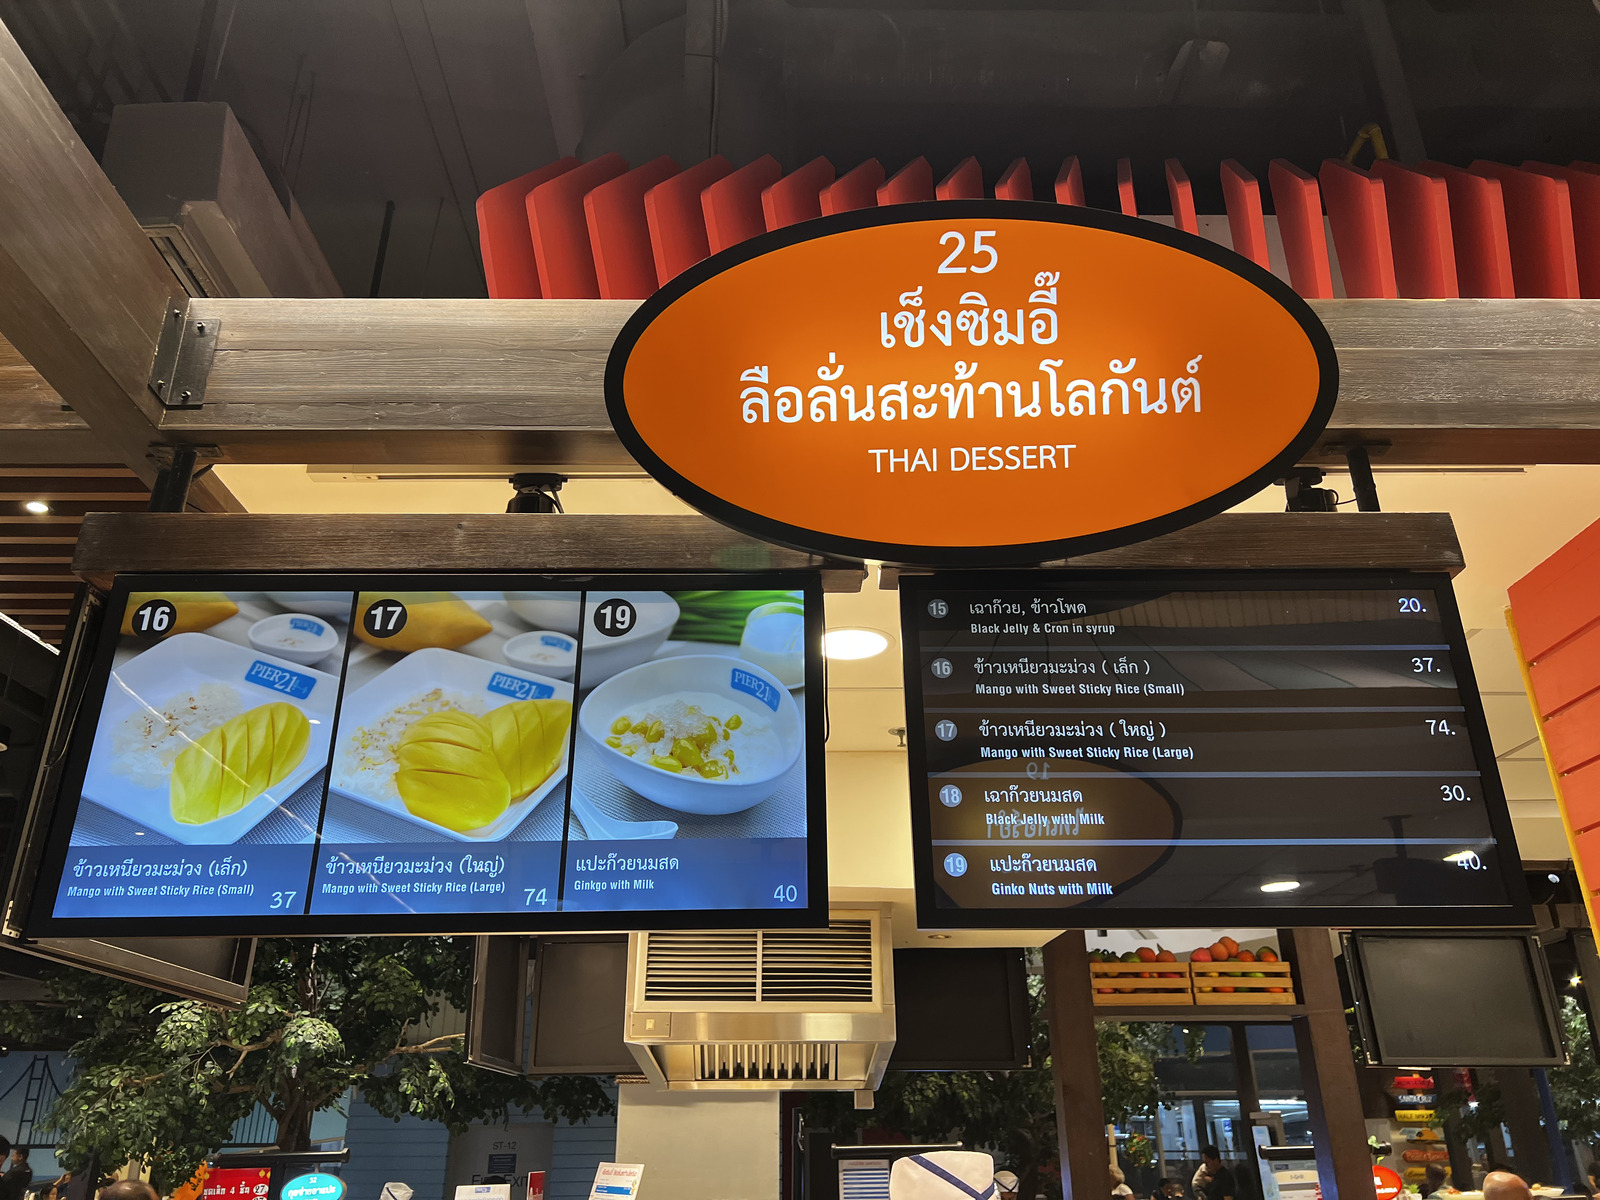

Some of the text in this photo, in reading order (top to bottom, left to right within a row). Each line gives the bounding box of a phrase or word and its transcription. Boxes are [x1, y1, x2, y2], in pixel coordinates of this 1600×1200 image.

[937, 230, 998, 274] 25
[739, 351, 1203, 424] ลือลั่นสะท้านโลกันต์
[867, 444, 1077, 473] THAI DESSERT
[929, 602, 947, 616] 15
[969, 597, 1087, 616] เฉาก๊วย, ข้าวโพด
[1398, 597, 1427, 613] 20.
[138, 606, 170, 631] 16
[371, 605, 403, 631] 17
[600, 605, 631, 630] 19
[970, 622, 1115, 636] Black Jelly & Cron in syrup
[933, 661, 951, 676] 16
[973, 657, 1096, 674] ข้าวเหนียวมะม่วง
[1411, 657, 1441, 673] 37.
[975, 683, 1185, 697] Mango with Sweet Sticky Rice (Small)
[937, 724, 955, 739] 17
[978, 718, 1104, 737] ข้าวเหนียวมะม่วง
[1425, 719, 1456, 736] 74.
[980, 746, 1194, 760] Mango with Sweet Sticky Rice (Large)
[941, 788, 960, 804] 18
[984, 784, 1083, 803] เฉาก๊วยนมสด
[1440, 784, 1471, 802] 30.
[985, 813, 1105, 828] Black Jelly with Milk
[73, 855, 248, 878] ข้าวเหนียวมะม่วง (เล็ก)
[325, 854, 505, 878] ข้าวเหนียวมะม่วง (ใหญ่)
[576, 852, 679, 872] แปะก๊วยนมสด
[946, 857, 965, 873] 19
[990, 852, 1097, 872] แปะก๊วยนมสด
[67, 884, 254, 899] Mango with Sweet Sticky Rice (Small)
[321, 881, 505, 896] Mango with Sweet Sticky Rice (Large)
[574, 879, 655, 892] Ginkgo with Milk
[773, 884, 798, 902] 40
[991, 882, 1114, 895] Ginko Nuts with Milk
[269, 891, 297, 909] 37
[523, 887, 548, 906] 74
